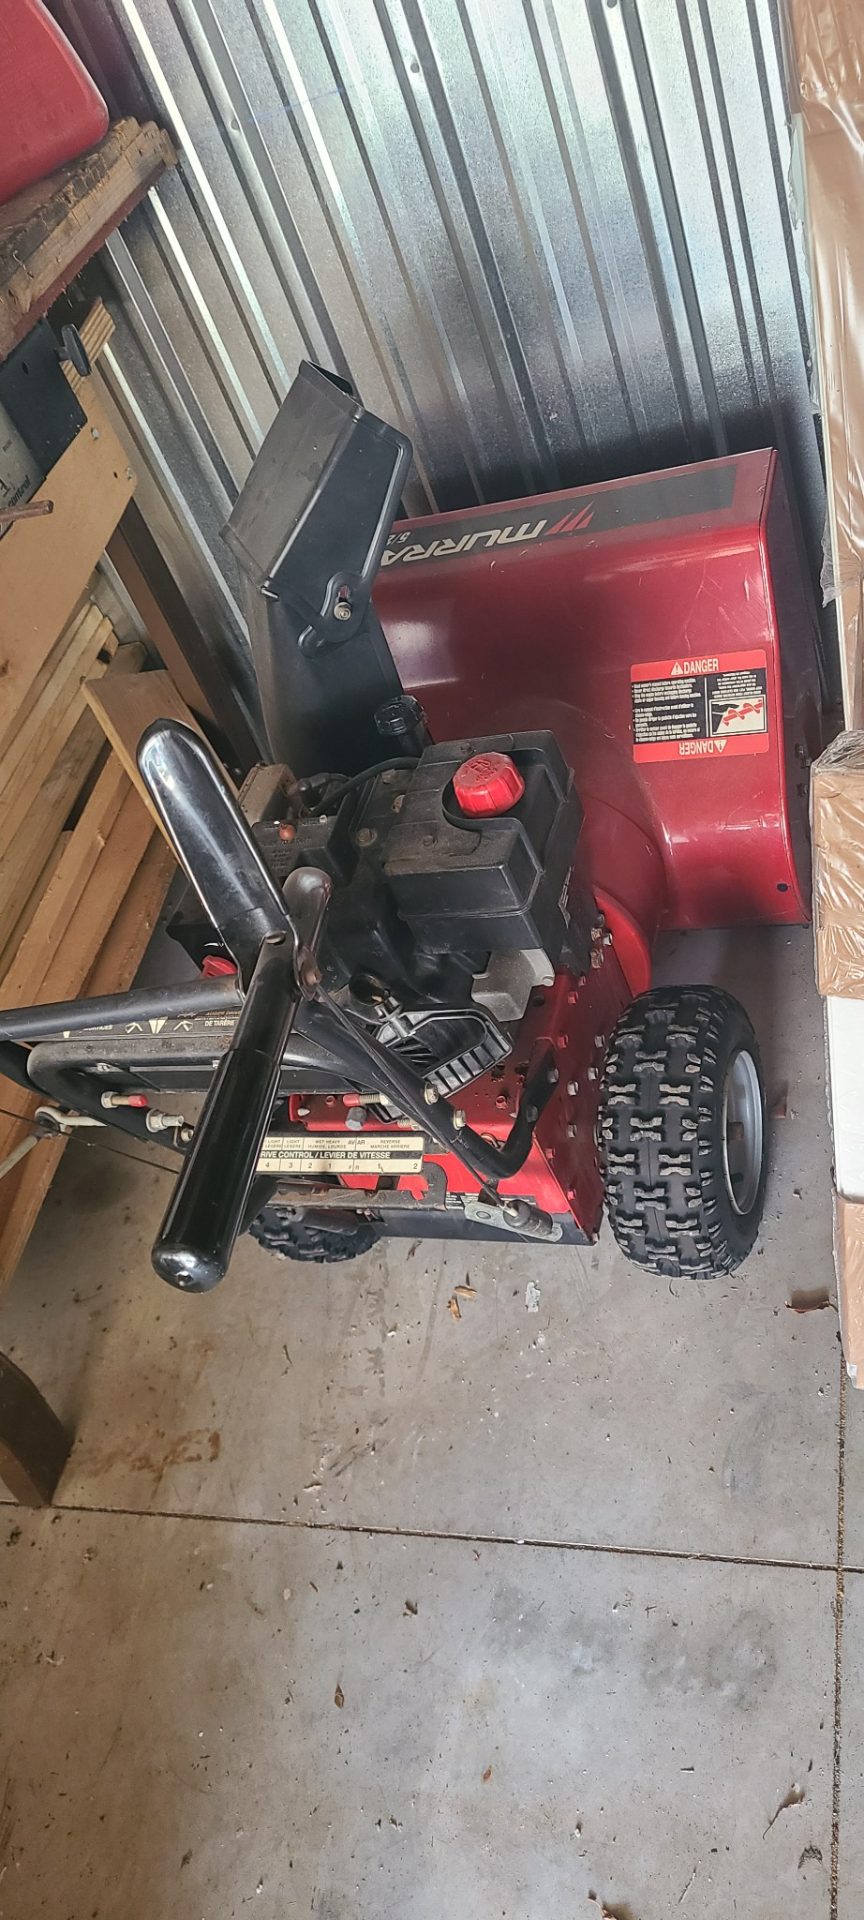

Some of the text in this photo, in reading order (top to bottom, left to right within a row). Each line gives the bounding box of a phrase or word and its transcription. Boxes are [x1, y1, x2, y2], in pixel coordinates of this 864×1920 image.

[381, 519, 547, 566] MURRA
[387, 532, 411, 545] 5/2
[684, 659, 719, 675] DANGER
[679, 740, 714, 755] DANGER
[260, 1151, 277, 1159] RIVE
[278, 1151, 314, 1159] CONTROL
[320, 1151, 346, 1159] LEVIER
[347, 1151, 358, 1159] DE
[359, 1151, 391, 1159] VITESSE
